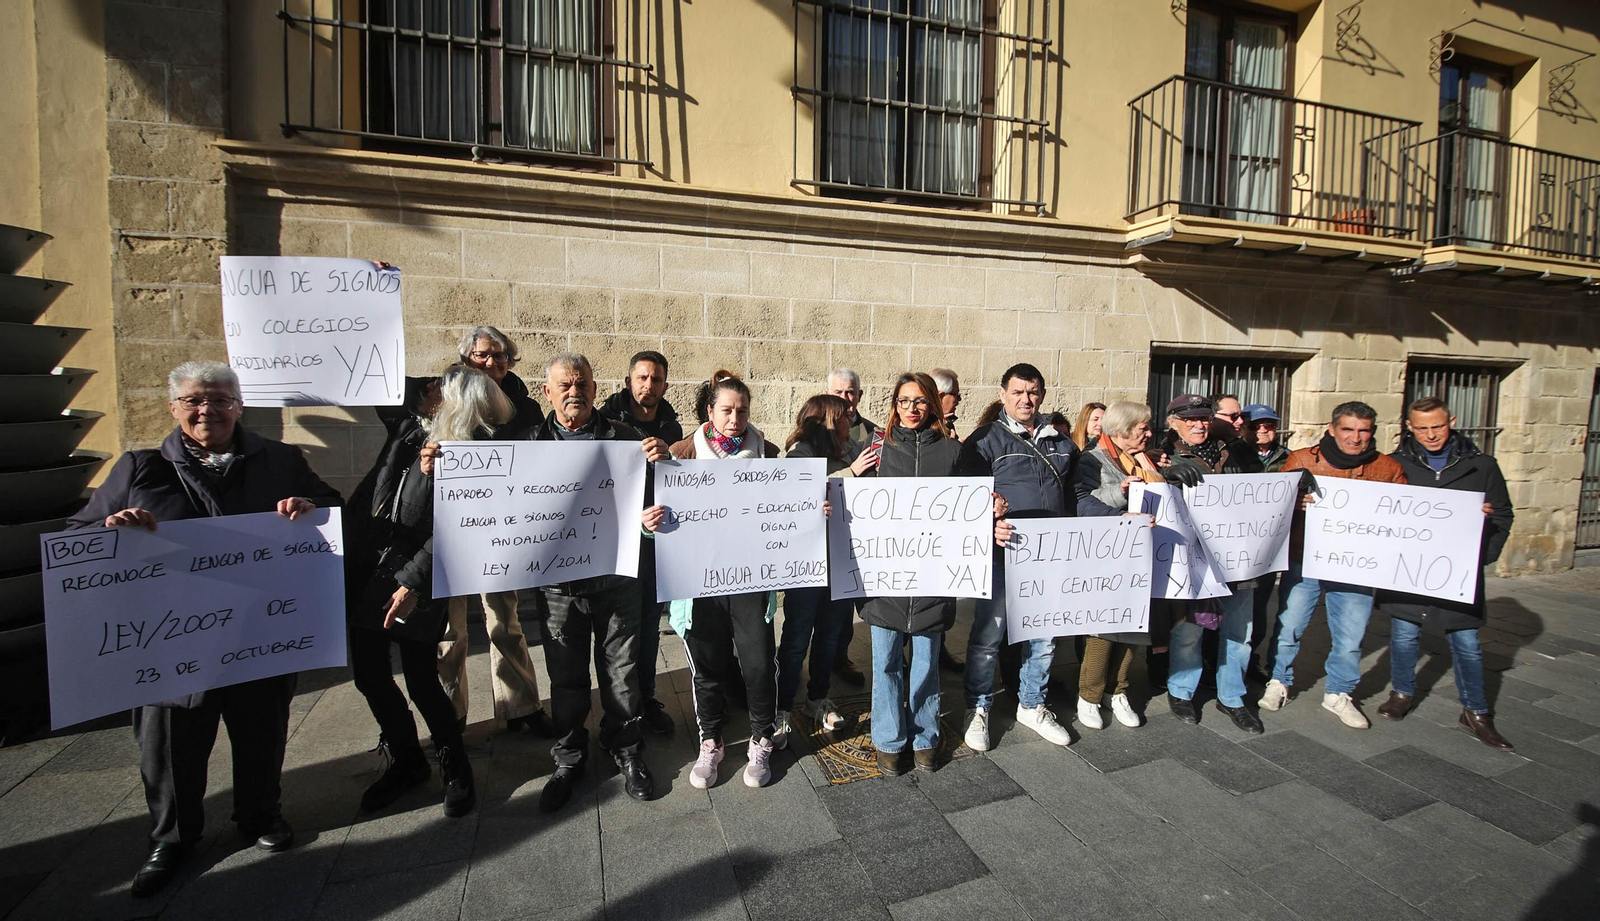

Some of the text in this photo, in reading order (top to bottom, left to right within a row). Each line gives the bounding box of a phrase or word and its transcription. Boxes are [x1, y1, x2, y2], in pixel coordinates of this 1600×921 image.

[222, 269, 401, 297] NGUA DE SIGNOS
[262, 316, 370, 335] COLEGIOS
[333, 338, 402, 400] YA!
[443, 447, 503, 471] BOJA
[506, 485, 515, 496] Y
[523, 481, 583, 495] RECONOCE
[597, 478, 615, 489] LA
[664, 470, 716, 489] NIÑOS/AS
[732, 467, 788, 485] SORDOS/AS
[460, 506, 603, 528] LENGUA DE SIGNOS EN
[668, 507, 728, 525] DERECHO
[756, 496, 818, 514] EDUCACIÓN
[1374, 495, 1453, 519] AÑOS
[760, 521, 798, 533] DIGNA
[1322, 518, 1433, 542] ESPERANDO
[51, 536, 105, 561] BOE
[765, 540, 789, 550] CON
[848, 532, 990, 560] BILINGÜE EN
[61, 563, 167, 593] RECONOCE
[189, 550, 245, 573] LENGUA
[253, 548, 273, 562] DE
[482, 562, 510, 576] LEY
[703, 559, 827, 589] LENGUA DE SIGNOS
[843, 564, 988, 596] JEREZ YA!
[1018, 572, 1149, 598] EN CENTRO DE
[98, 598, 298, 657] LEY/2007 DE
[135, 635, 315, 685] 23 DE OCTUBRE
